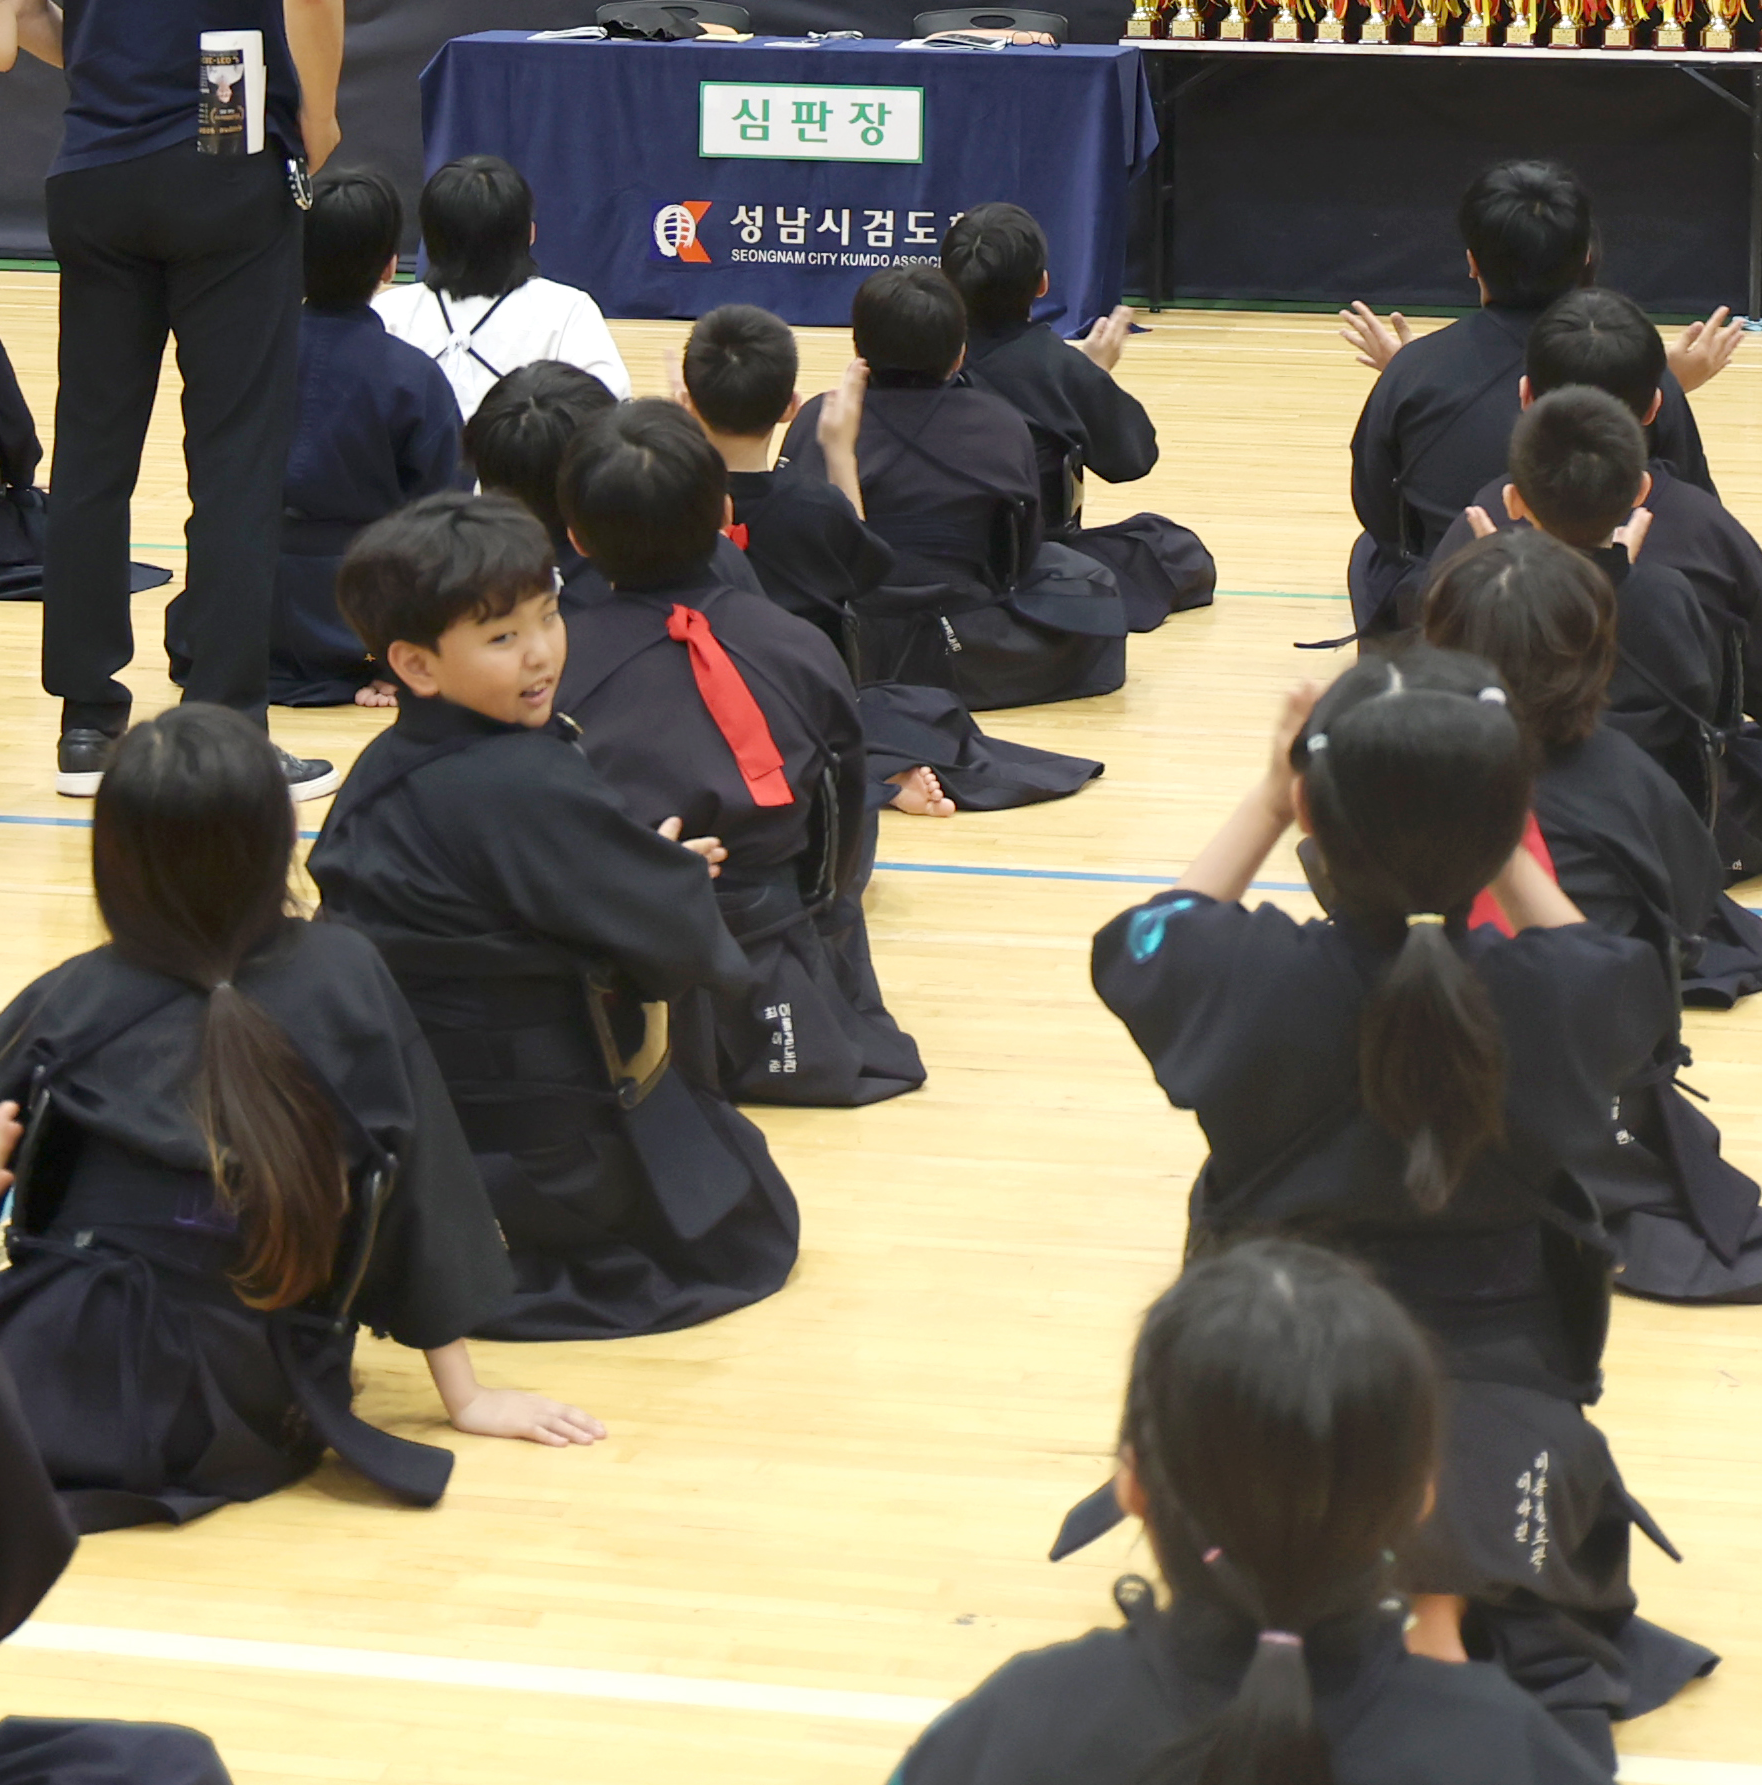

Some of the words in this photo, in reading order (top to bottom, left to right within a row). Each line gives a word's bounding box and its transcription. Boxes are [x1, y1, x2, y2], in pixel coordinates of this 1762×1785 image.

[731, 99, 892, 146] 심판장
[730, 205, 964, 248] 성남시검도
[731, 248, 806, 265] SEONGNAM
[808, 251, 838, 266] CITY
[840, 252, 889, 268] KUMDO
